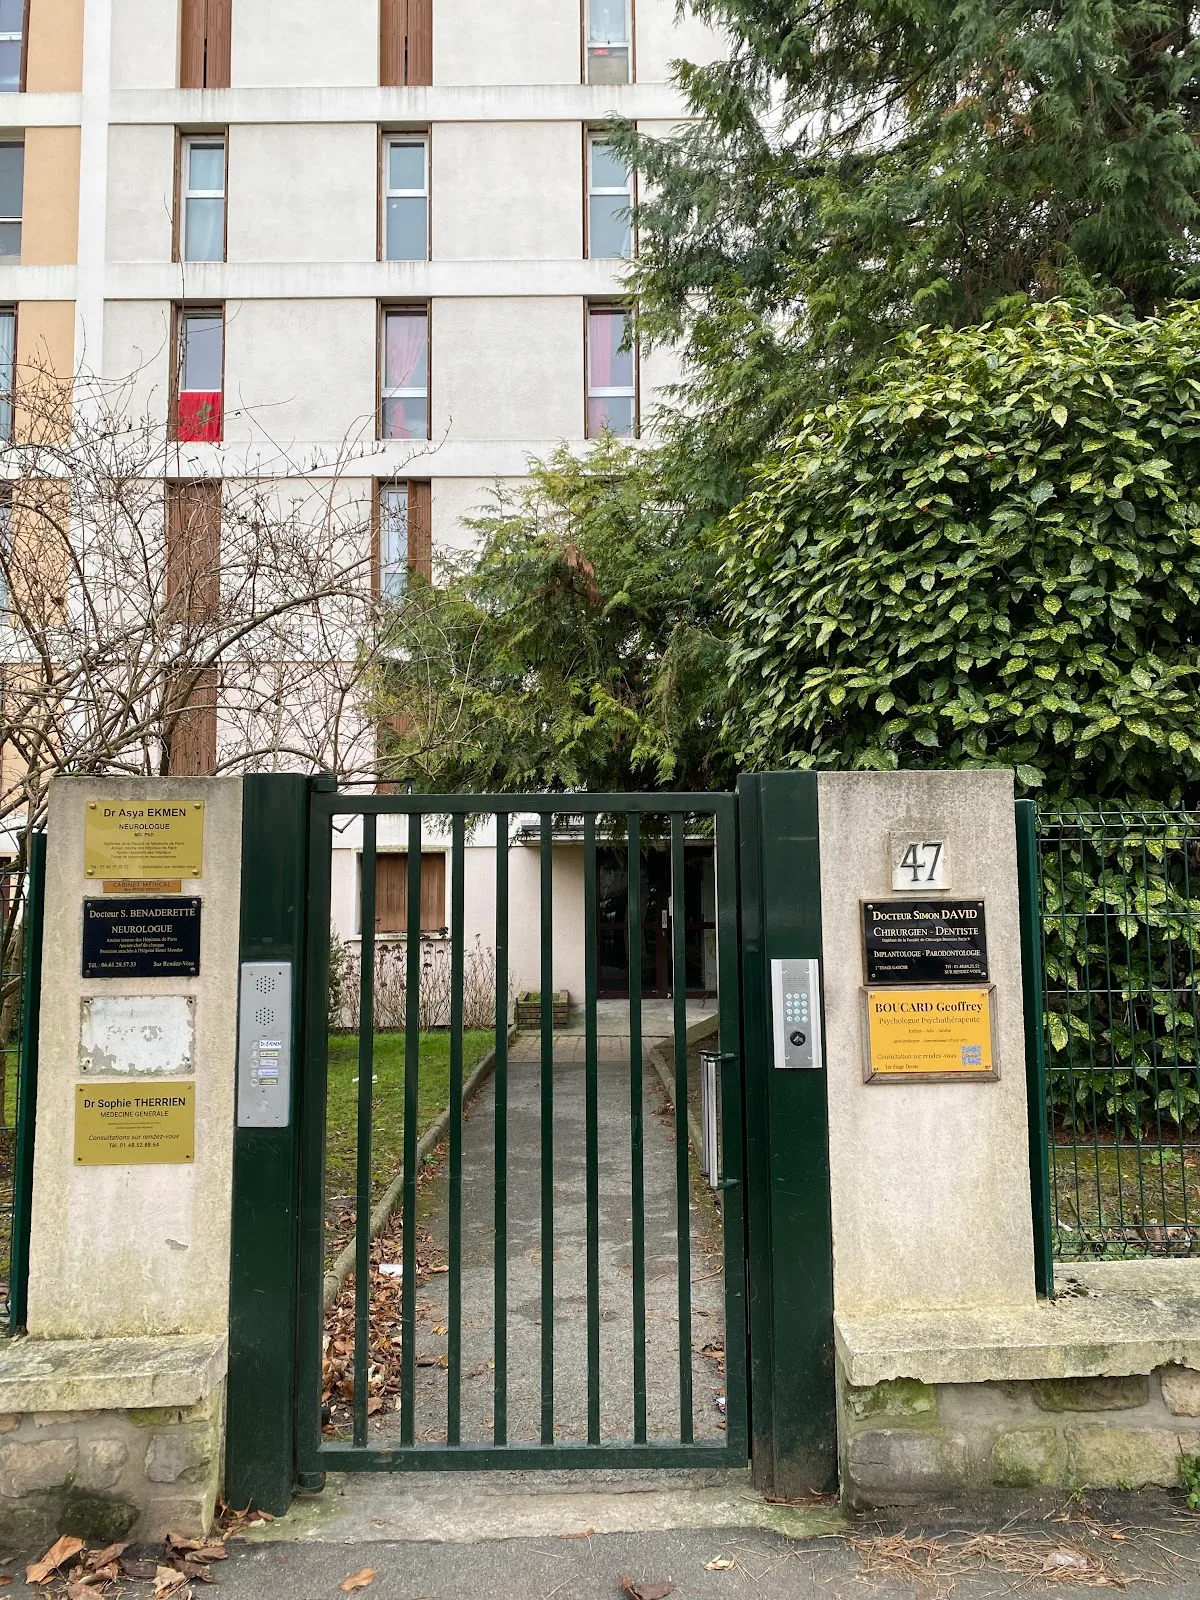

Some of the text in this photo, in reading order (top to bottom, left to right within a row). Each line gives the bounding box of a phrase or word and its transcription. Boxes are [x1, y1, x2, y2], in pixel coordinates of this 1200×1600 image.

[104, 808, 186, 819] Dr Asya EKMEN
[900, 842, 942, 882] 47
[89, 910, 119, 918] Docteur
[130, 908, 195, 917] BENADERETTE
[941, 910, 978, 920] DAVID
[112, 925, 172, 933] NEUROLOGUE
[875, 1001, 983, 1013] BOUCARD Geoffrey
[879, 1016, 980, 1025] Psychologue Psychothérapeute
[84, 1097, 186, 1109] Dr Sophie THERRIEN
